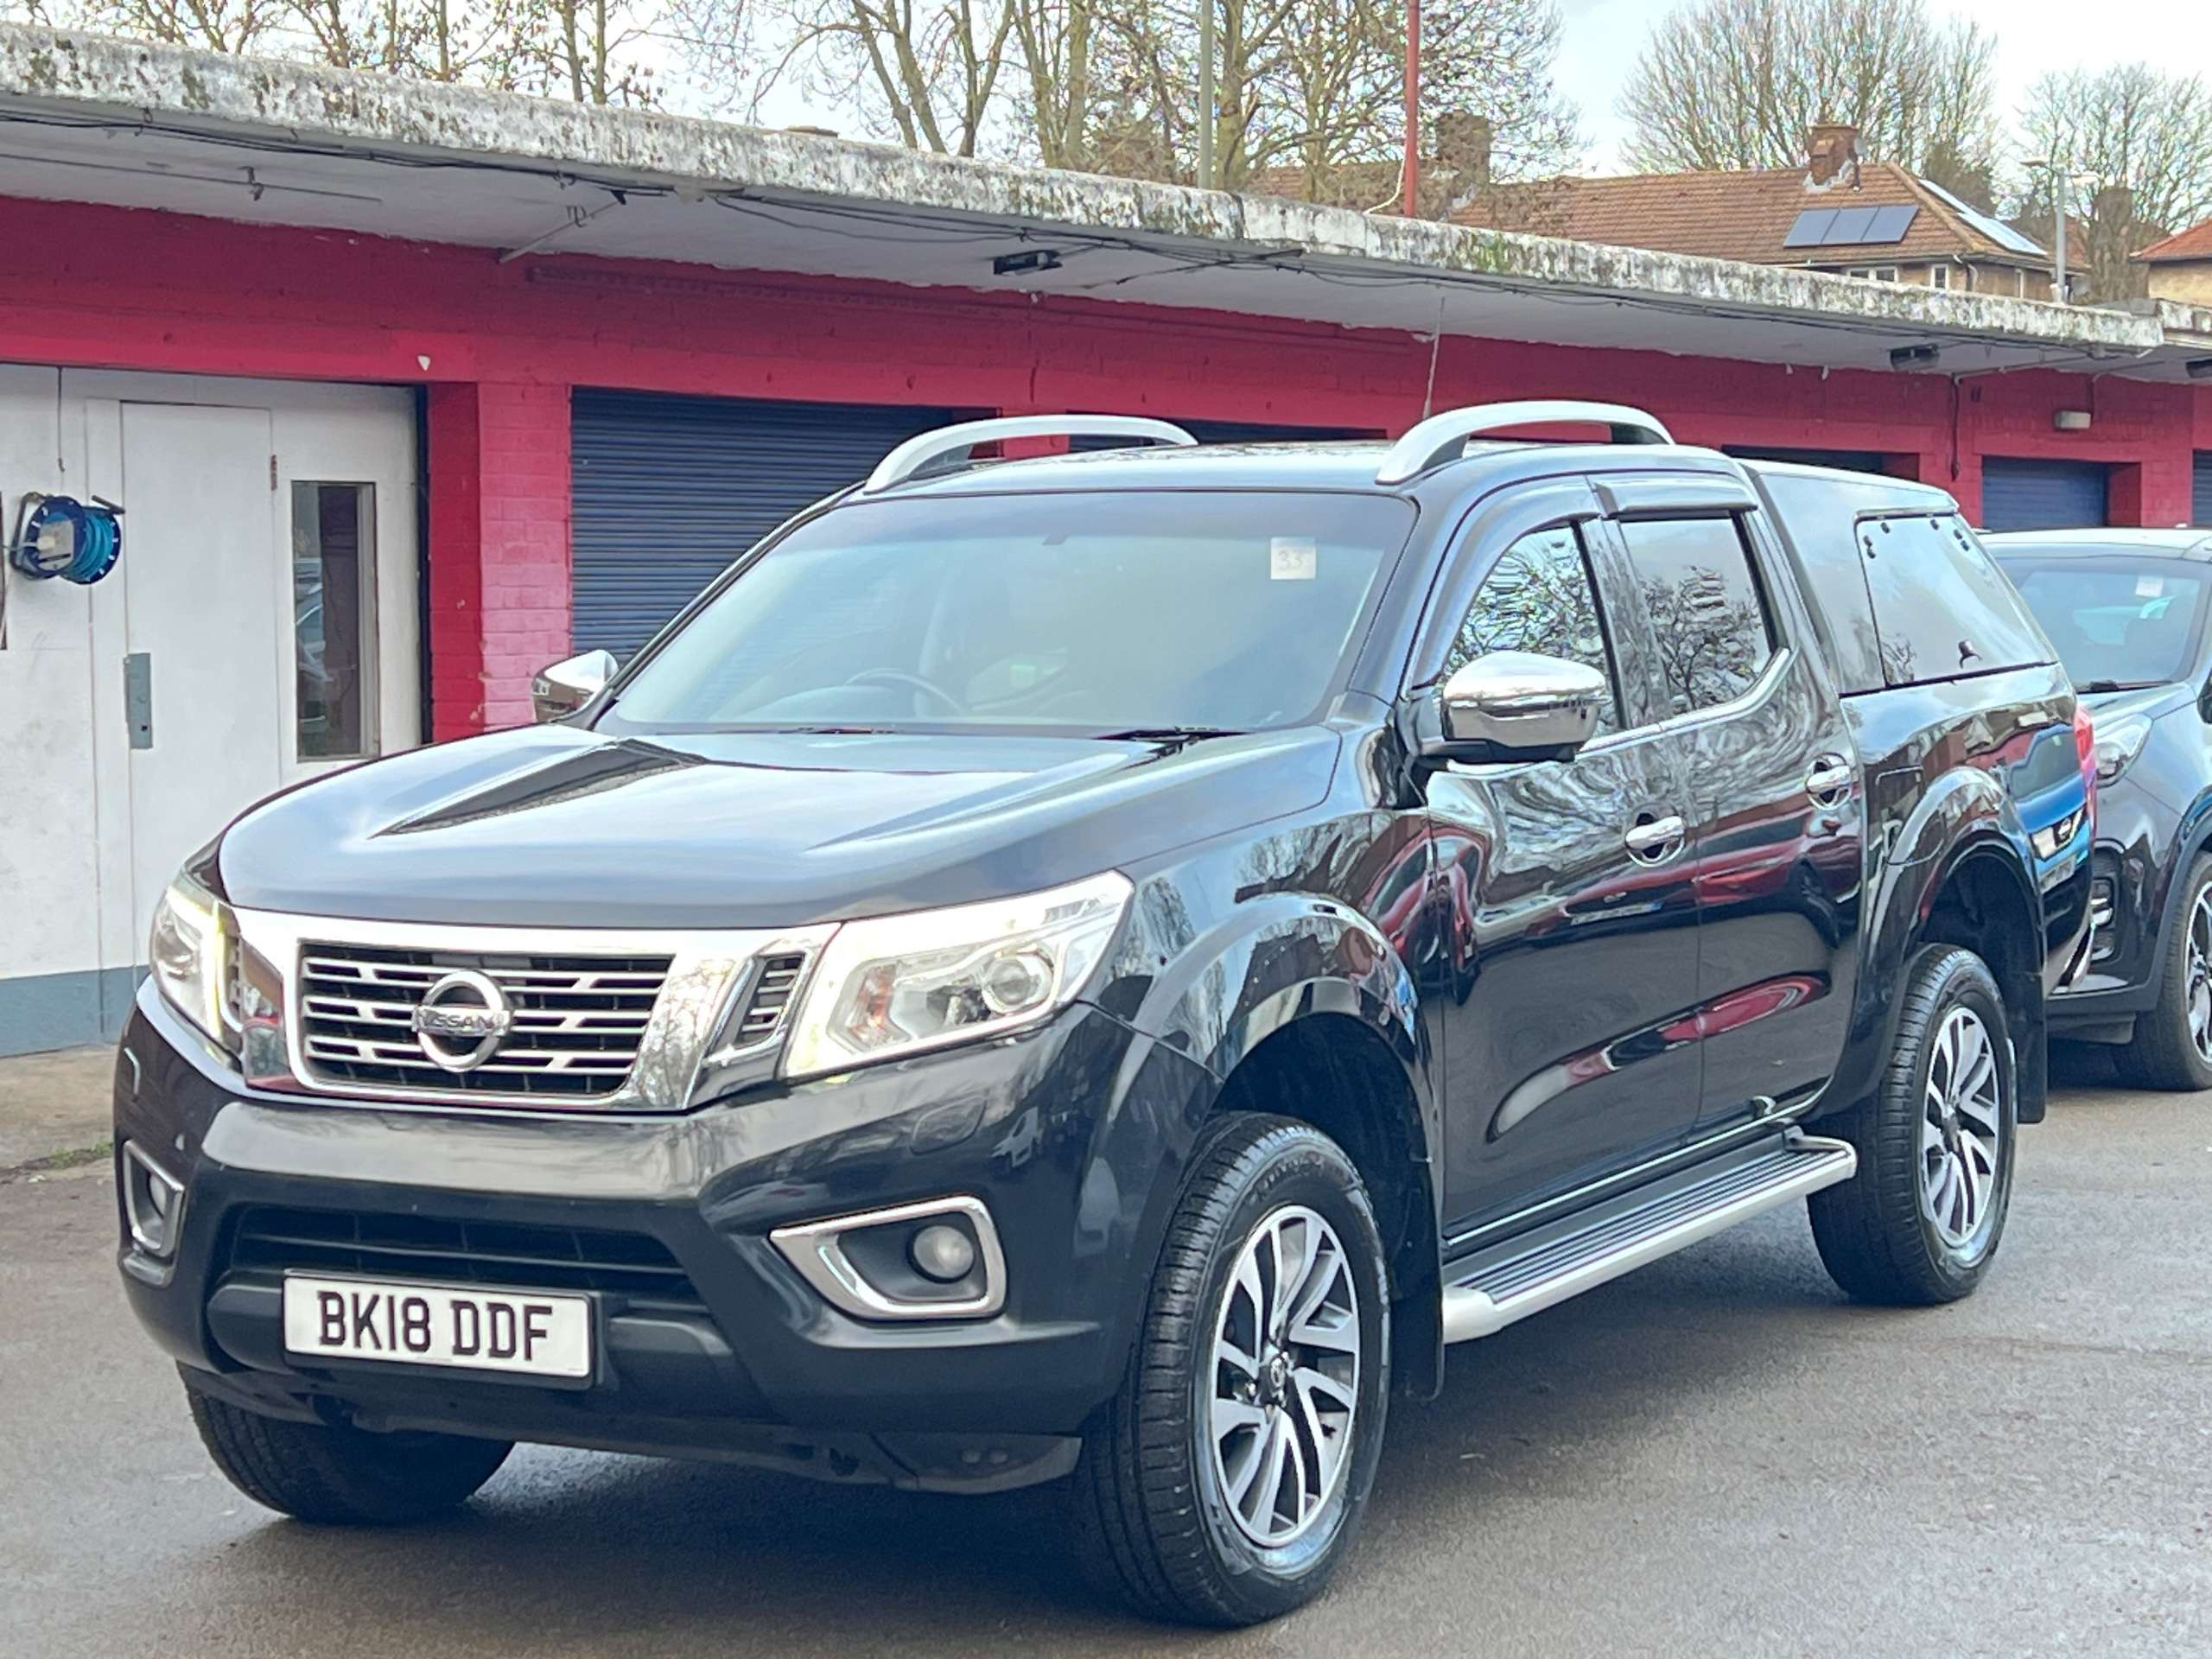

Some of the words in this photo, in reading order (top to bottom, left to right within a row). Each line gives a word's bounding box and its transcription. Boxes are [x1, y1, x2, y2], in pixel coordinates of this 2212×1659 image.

[416, 1007, 495, 1030] NISSAN
[316, 1290, 431, 1353] BK18
[450, 1300, 553, 1362] DDF
